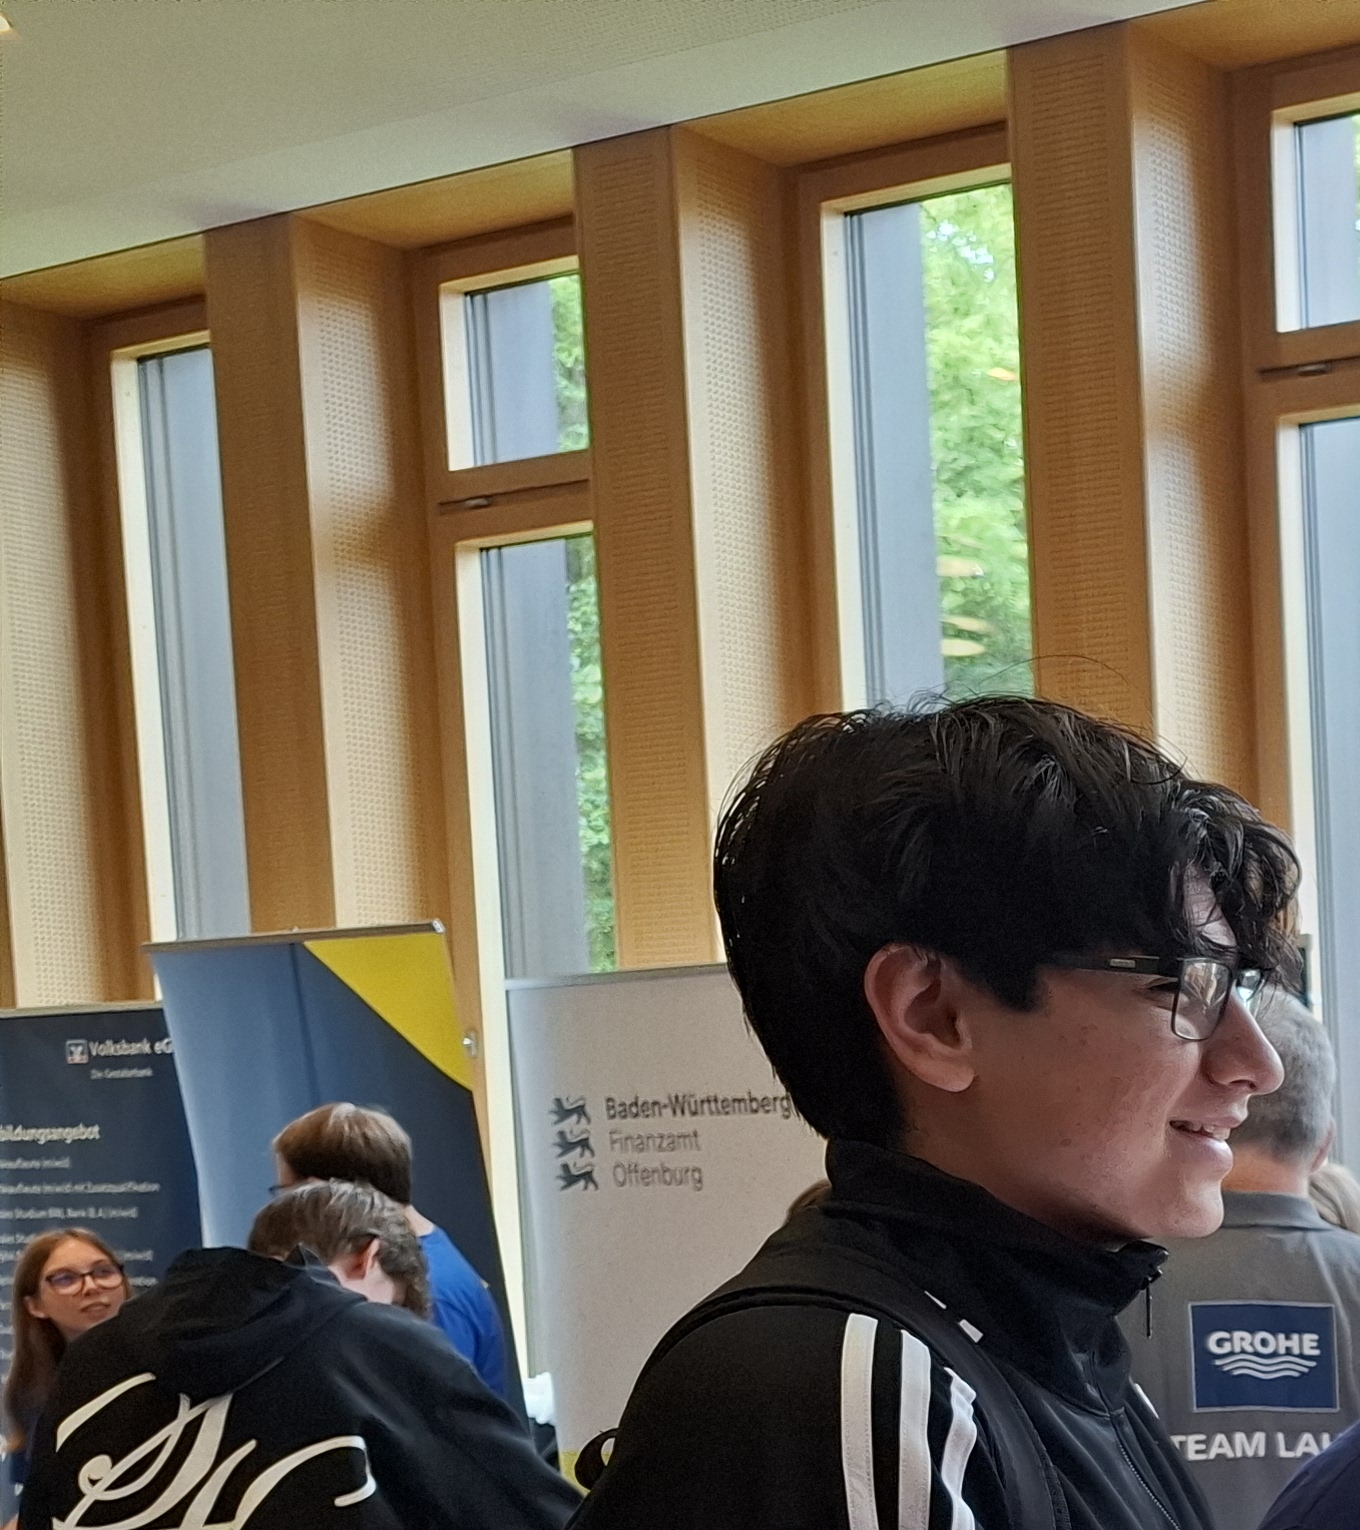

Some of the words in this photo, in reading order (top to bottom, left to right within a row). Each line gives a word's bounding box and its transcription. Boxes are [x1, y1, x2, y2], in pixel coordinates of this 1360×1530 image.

[605, 1090, 791, 1121] Baden-Württemberg
[608, 1129, 700, 1153] Finanzamt
[612, 1163, 704, 1192] Offenburg
[1207, 1330, 1321, 1356] GROHE
[1170, 1431, 1266, 1461] TEAM
